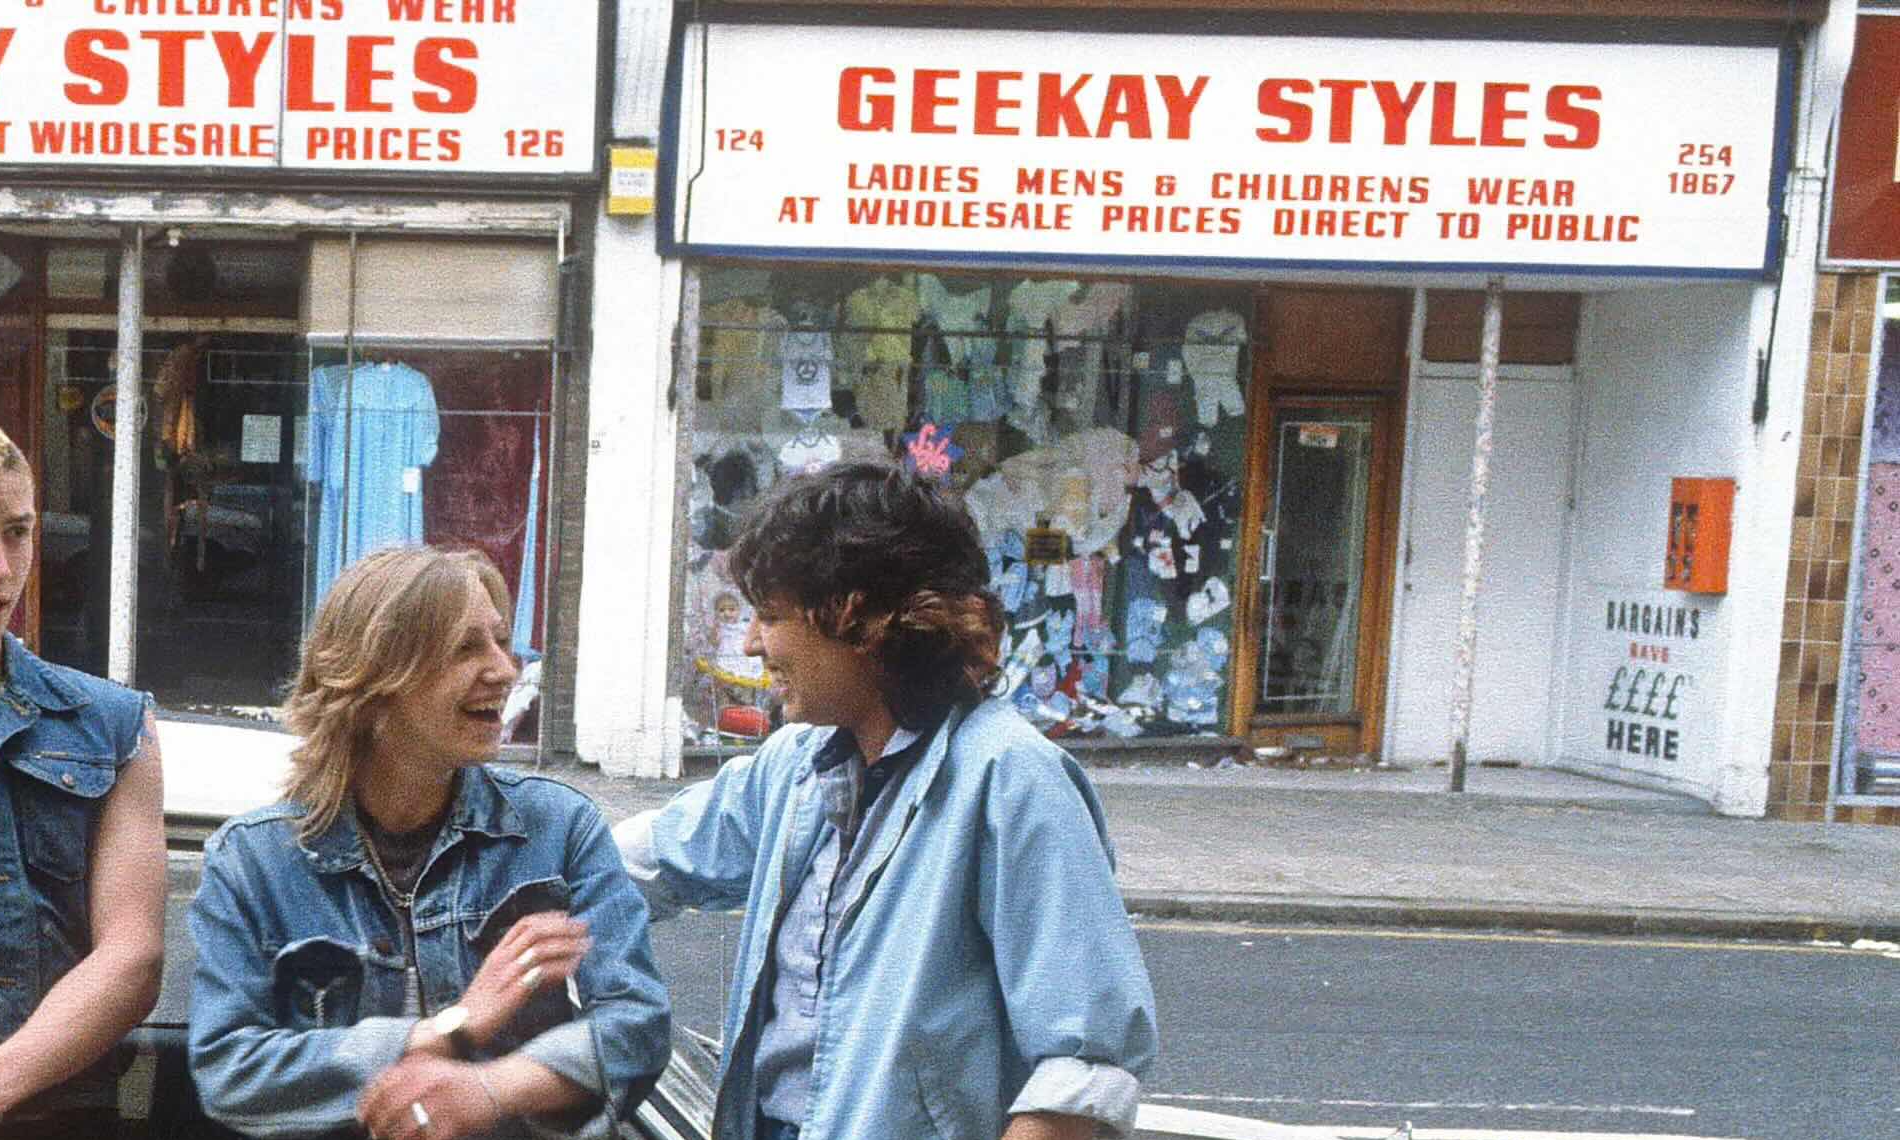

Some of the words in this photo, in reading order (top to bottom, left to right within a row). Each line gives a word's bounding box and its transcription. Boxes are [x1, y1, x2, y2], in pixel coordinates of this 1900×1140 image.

[62, 27, 480, 115] STYLES
[836, 66, 1211, 141] GEEKAY
[1255, 78, 1604, 150] STYLES
[28, 120, 277, 158] WHOLESALE
[306, 127, 462, 163] PRICES
[504, 129, 566, 159] 126
[715, 128, 766, 152] 124
[1677, 143, 1734, 168] 254
[846, 163, 981, 194] LADIES
[1015, 167, 1126, 198] MENS
[1154, 175, 1177, 197] &
[1209, 172, 1431, 205] CHILDRENS
[1466, 177, 1576, 208] WEAR
[1668, 172, 1736, 197] 1867
[777, 195, 820, 225] AT
[846, 197, 1073, 232] WHOLESALE
[1100, 204, 1242, 236] PRICES
[1271, 207, 1409, 240] DIRECT
[1438, 211, 1482, 241] TO
[1506, 212, 1641, 243] PUBLIC
[1605, 600, 1701, 640] BARGAINS
[1605, 718, 1680, 762] HERE
